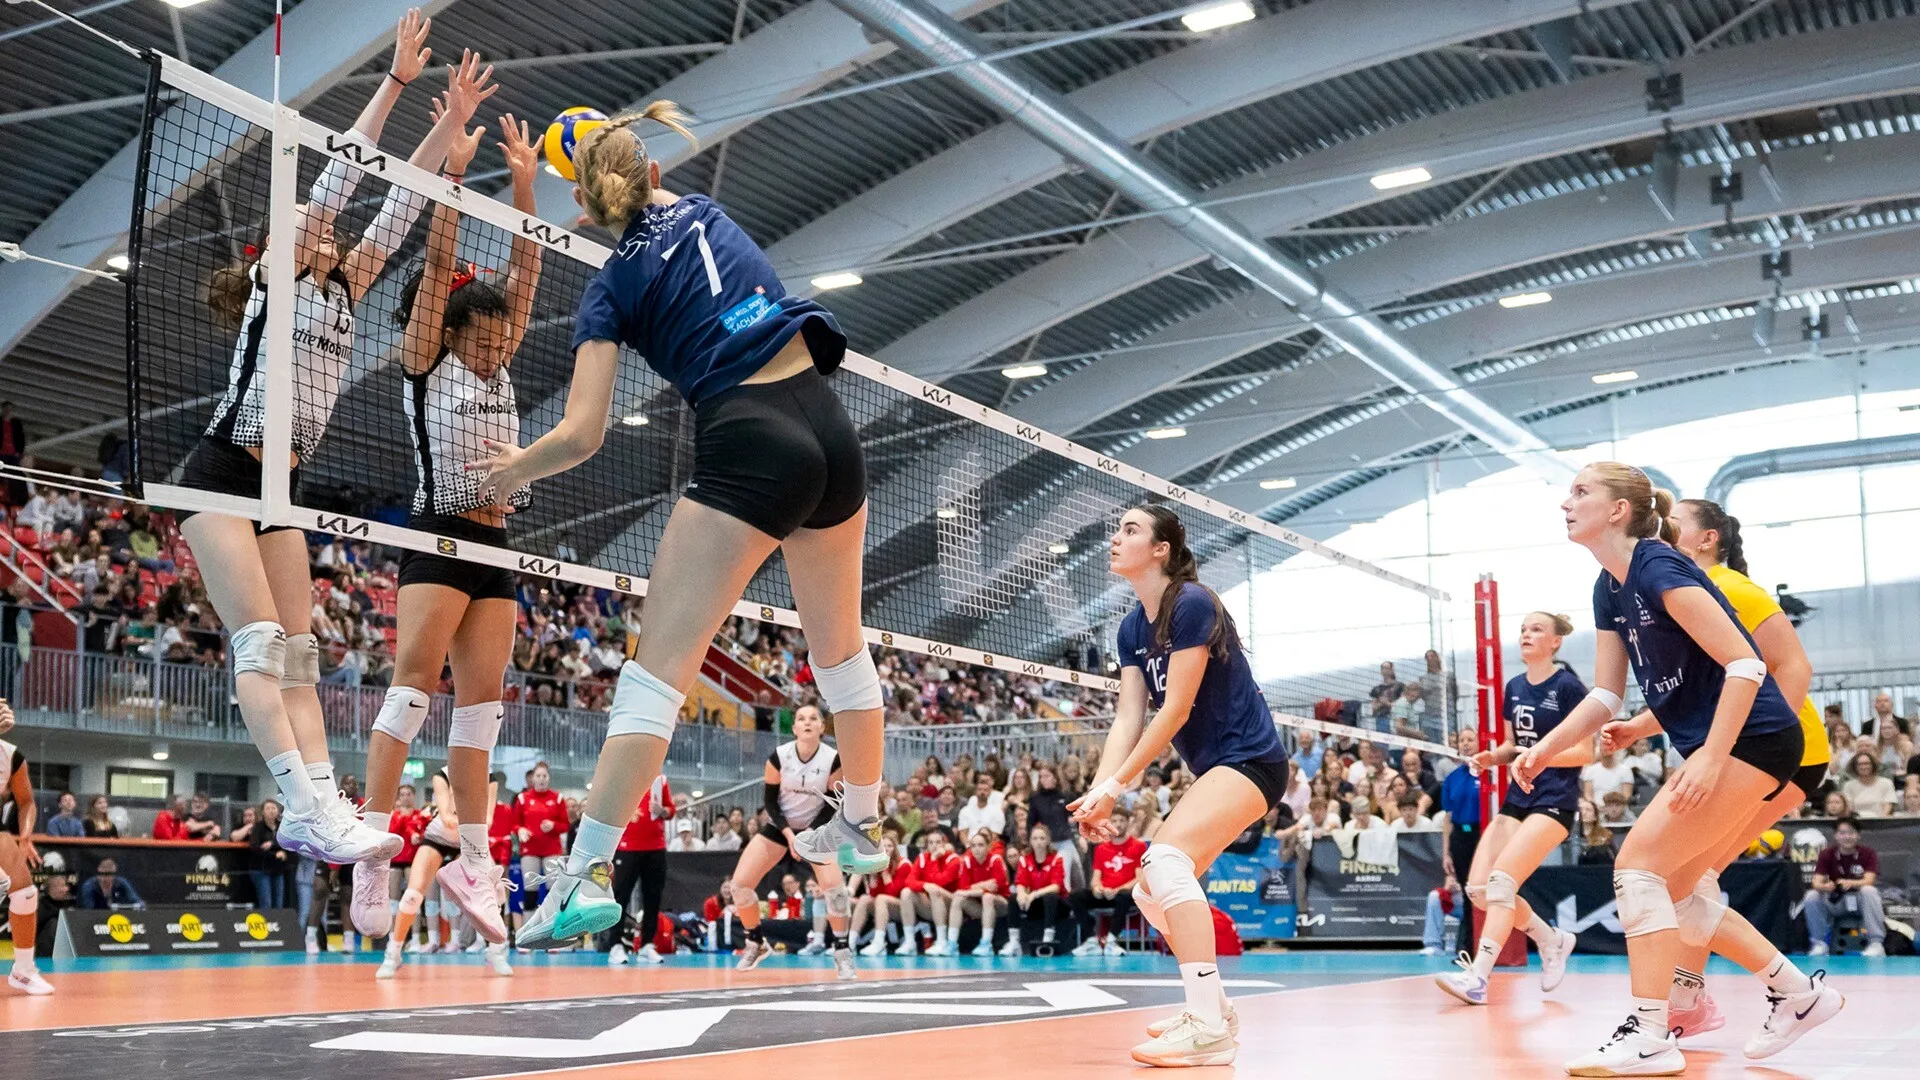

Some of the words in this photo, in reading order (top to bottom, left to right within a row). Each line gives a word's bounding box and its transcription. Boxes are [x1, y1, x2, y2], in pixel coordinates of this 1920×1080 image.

[326, 134, 386, 173] KIA
[522, 218, 571, 250] KIA
[317, 513, 369, 537] KIA
[518, 554, 561, 578] KIA
[1655, 667, 1684, 693] win!
[1512, 704, 1535, 730] 15
[185, 873, 220, 885] FINAL
